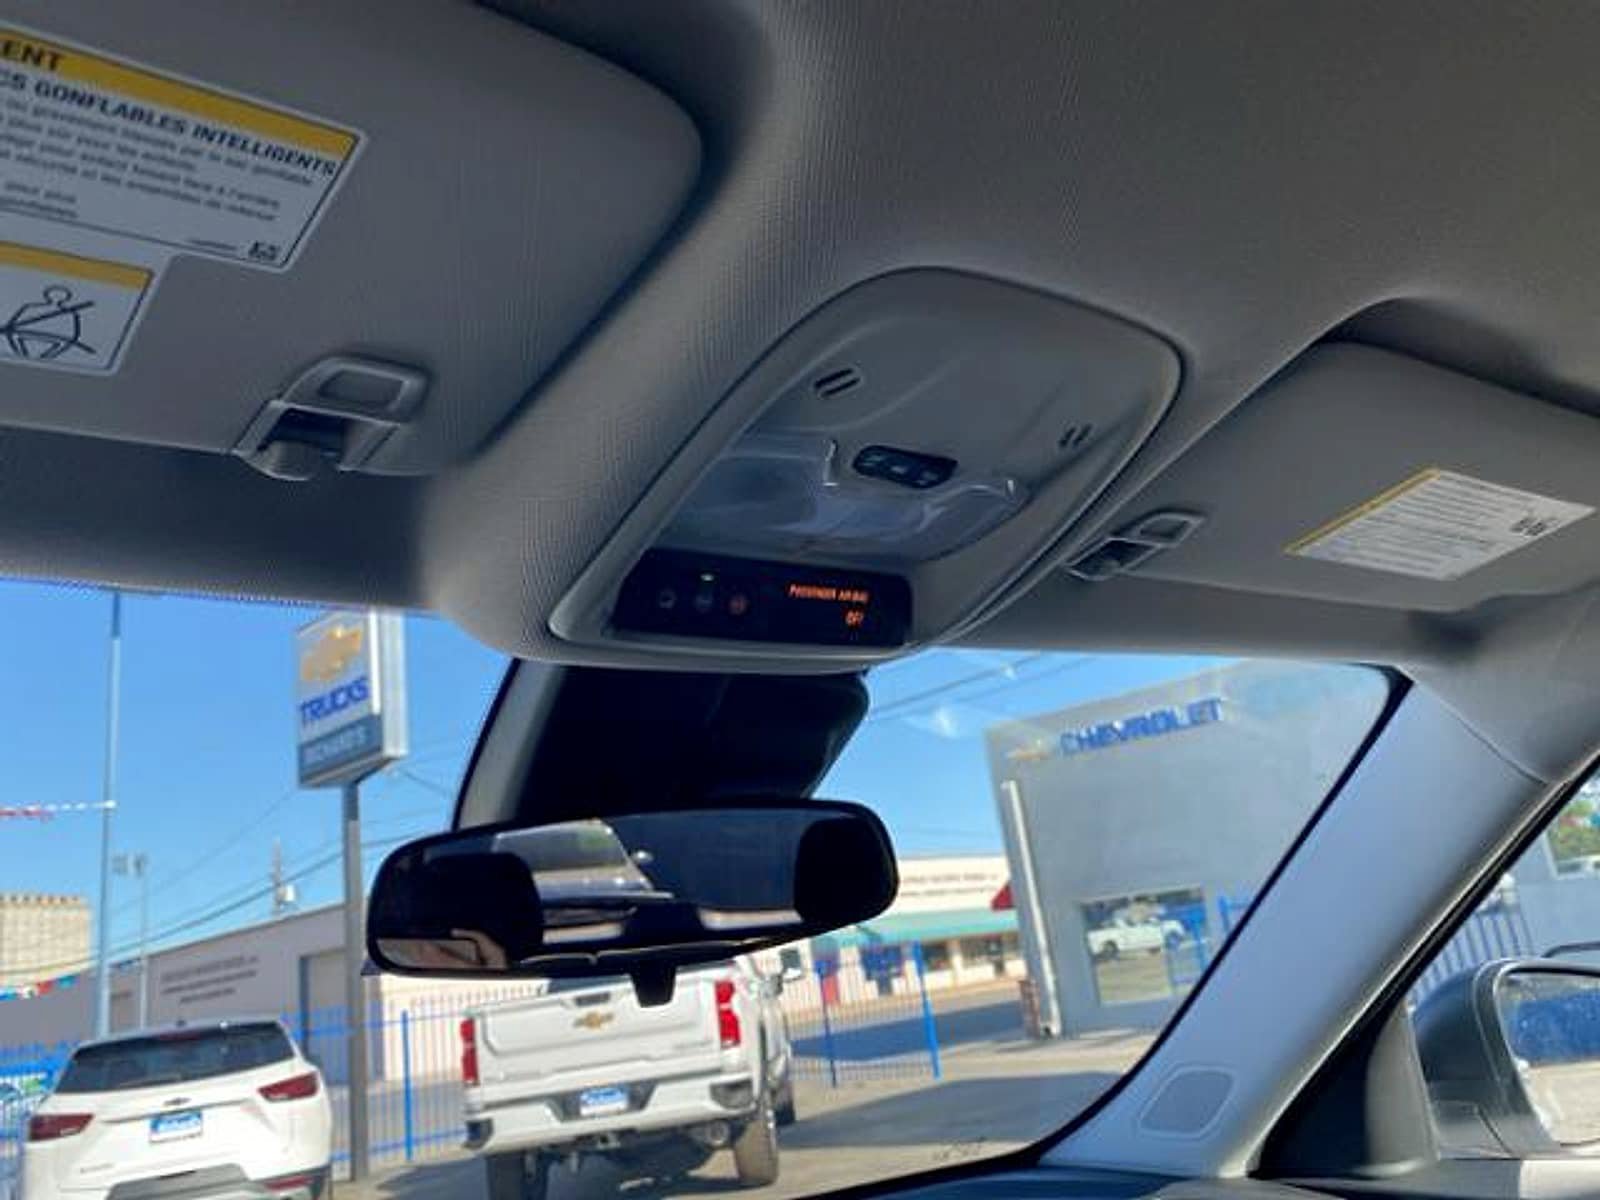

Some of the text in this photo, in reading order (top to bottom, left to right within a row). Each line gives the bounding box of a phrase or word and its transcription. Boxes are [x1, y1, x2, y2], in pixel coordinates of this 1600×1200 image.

[192, 123, 336, 176] INTELLIGENTS
[300, 676, 370, 728] TRUCKS
[1060, 698, 1222, 756] CHEVROLET
